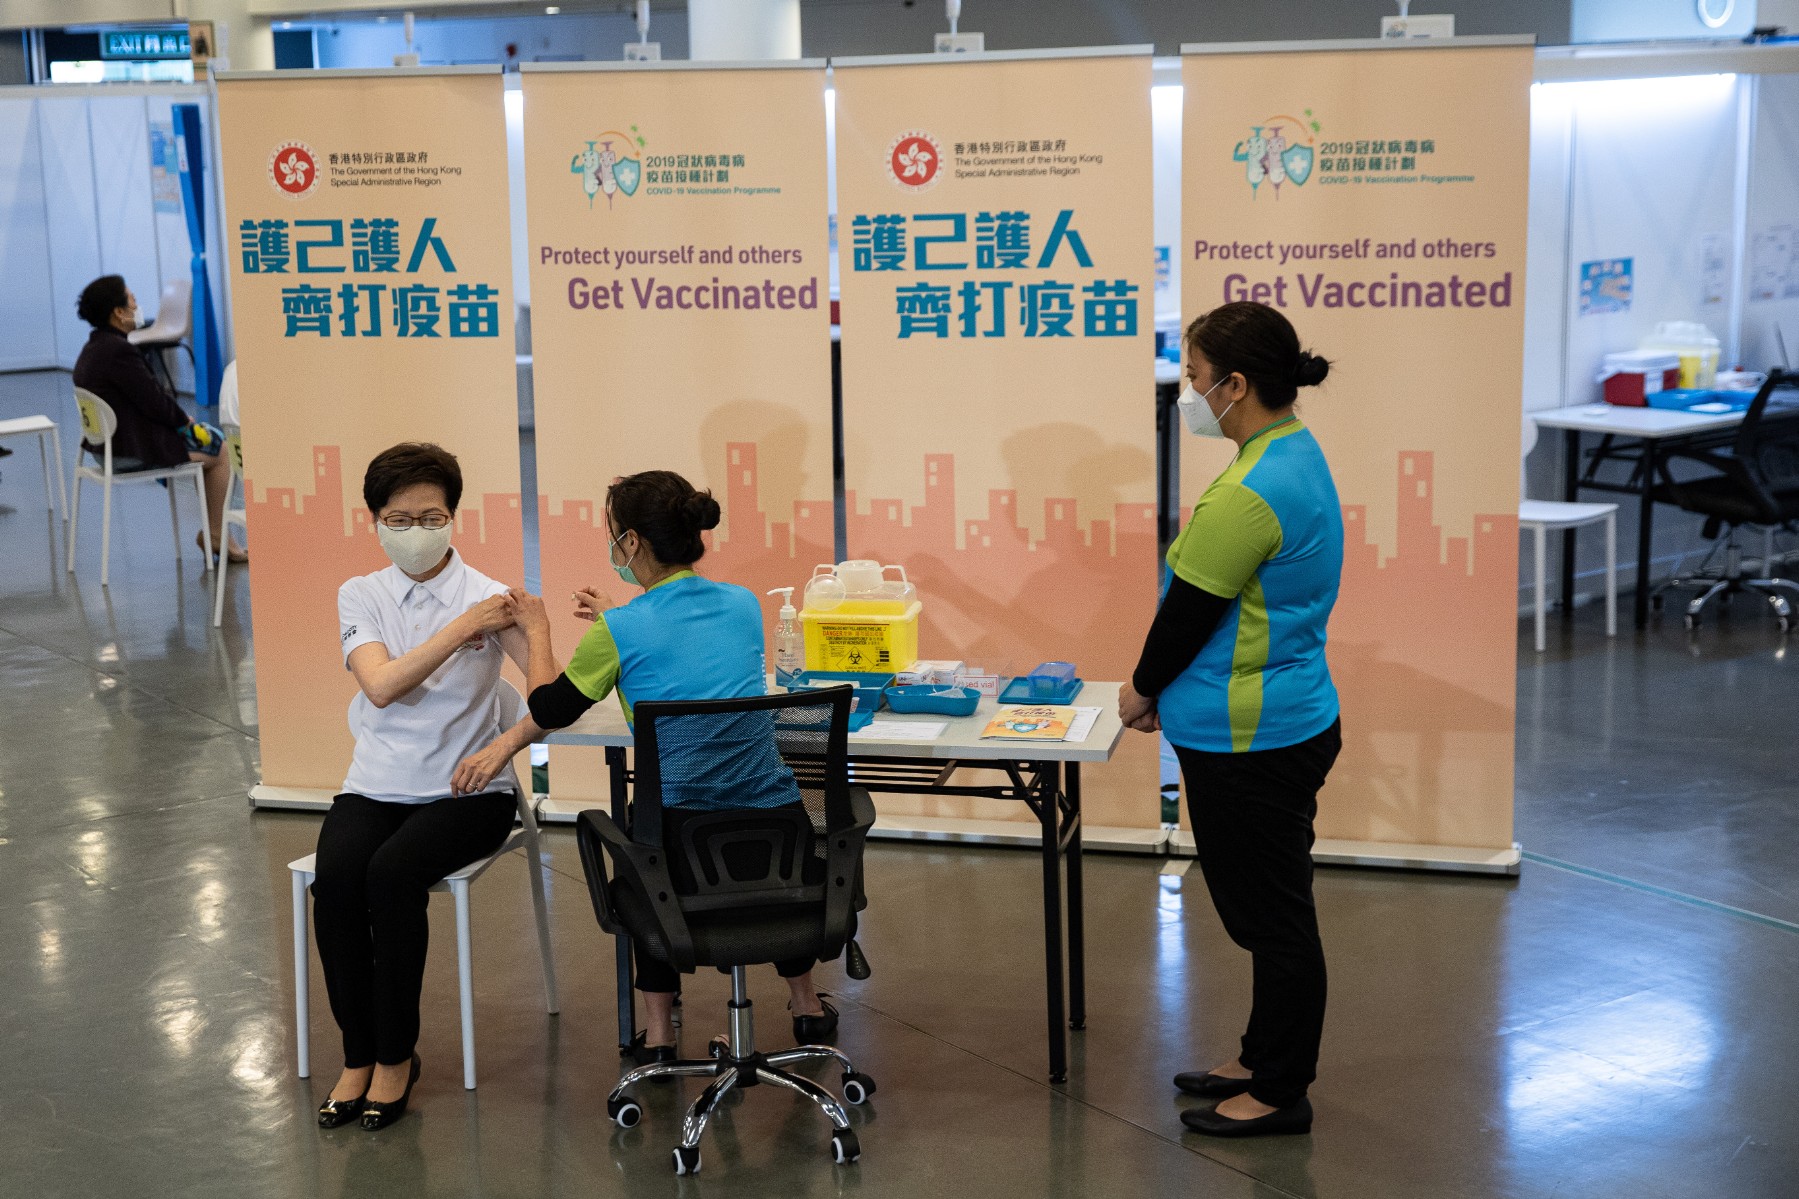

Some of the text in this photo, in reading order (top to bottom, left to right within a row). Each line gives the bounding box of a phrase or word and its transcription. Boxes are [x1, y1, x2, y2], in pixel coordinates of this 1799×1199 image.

[954, 139, 1066, 155] 香港特別行政區政府
[328, 151, 429, 165] 香港特別行政區政府
[955, 153, 1103, 166] The Government of the Hong Kong
[330, 165, 462, 176] The Government of the Hong Kong
[646, 169, 729, 183] 疫苗接種計劃
[955, 166, 1081, 179] Special Administrative Region
[330, 176, 442, 188] Special Administrative Region
[1365, 174, 1418, 184] Vaccination
[1419, 173, 1475, 184] Programme
[687, 186, 731, 195] Vaccination
[733, 186, 781, 196] Programme
[239, 217, 458, 274] 護己護人
[851, 209, 1094, 272] 護己護人
[540, 245, 803, 270] Protect yourself and others
[1194, 238, 1497, 265] Protect yourself and others
[568, 277, 818, 310] Get Vaccinated
[1223, 272, 1512, 308] Get Vaccinated
[281, 283, 499, 338] 齊打疫苗
[895, 279, 1139, 339] 齊打疫苗
[981, 680, 995, 688] vial
